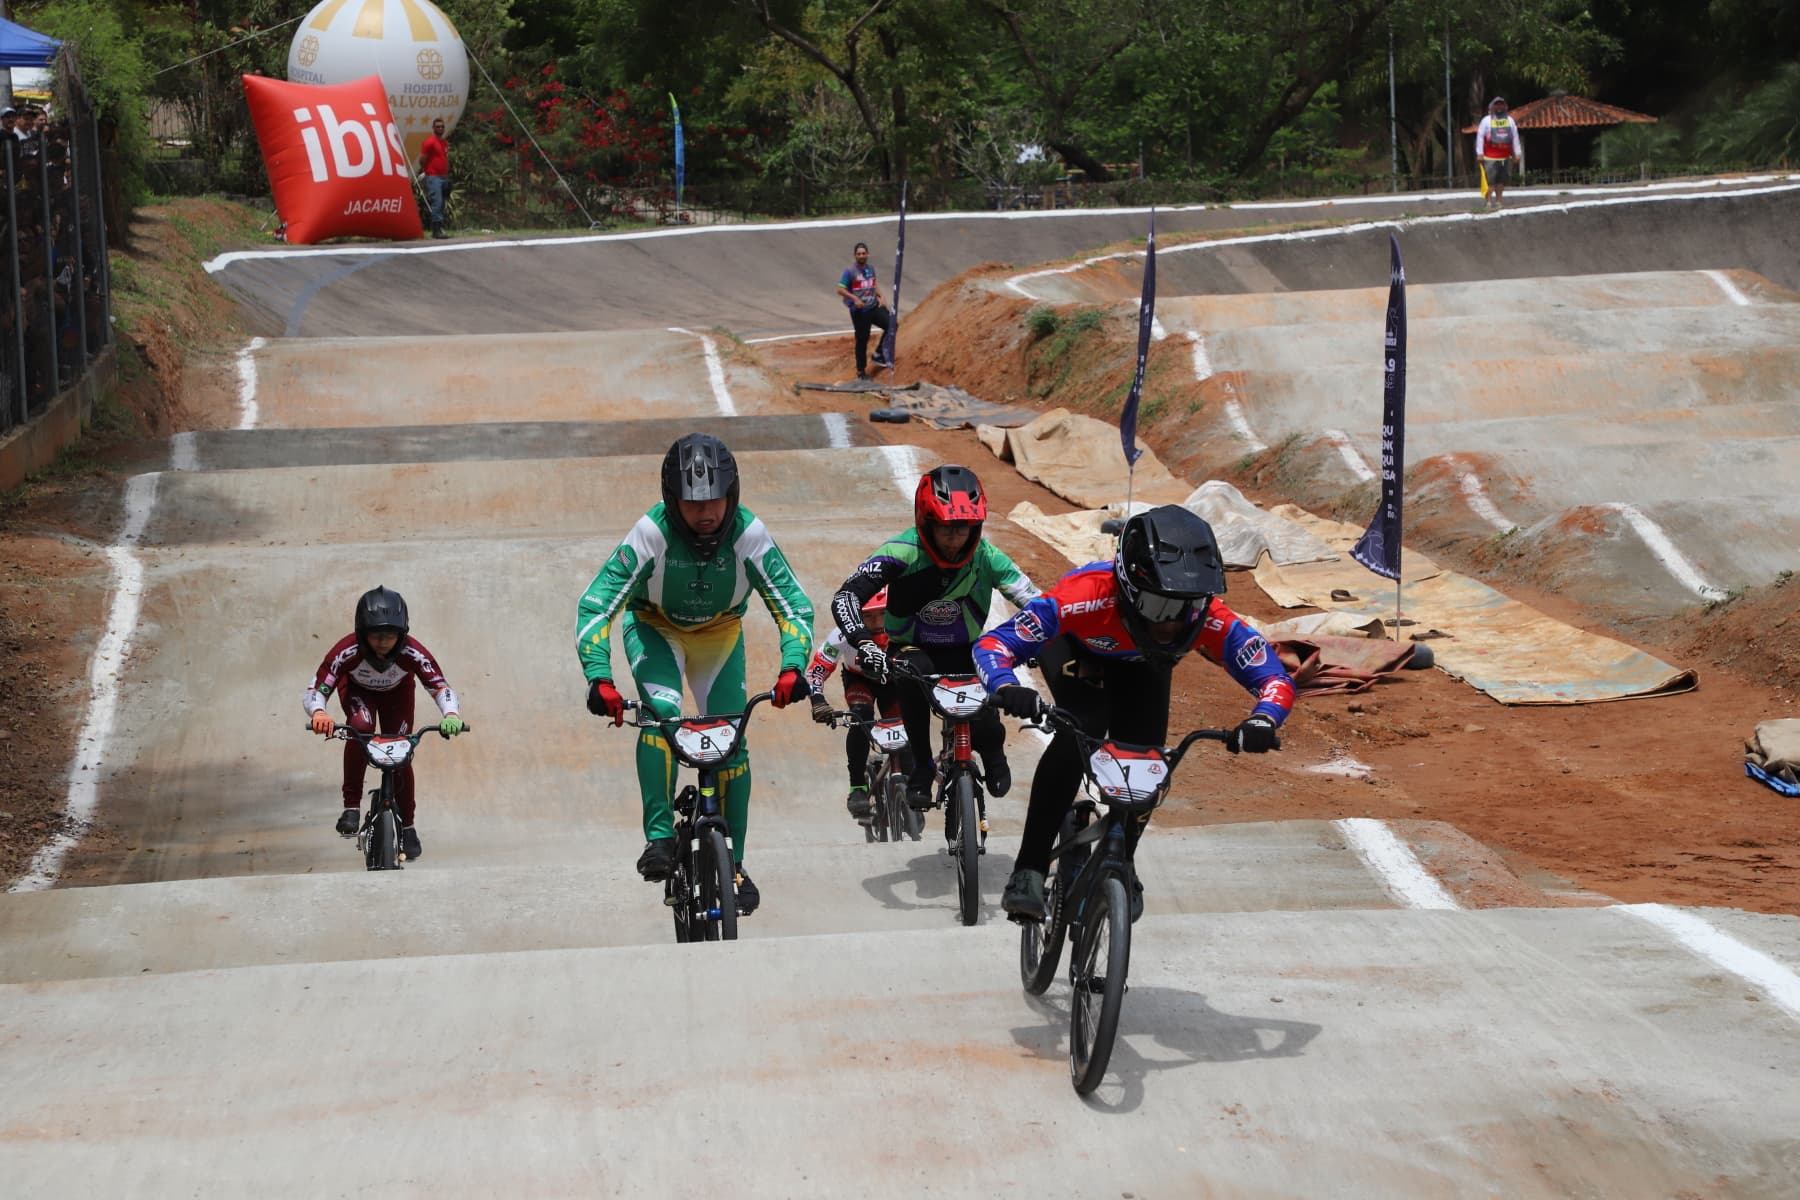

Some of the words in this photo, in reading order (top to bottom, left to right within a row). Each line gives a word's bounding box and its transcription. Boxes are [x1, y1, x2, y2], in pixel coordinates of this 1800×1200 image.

[403, 83, 454, 94] HOSPITAL
[293, 102, 409, 182] ibis
[886, 730, 900, 741] 10
[700, 736, 711, 750] 8
[386, 745, 394, 755] 2
